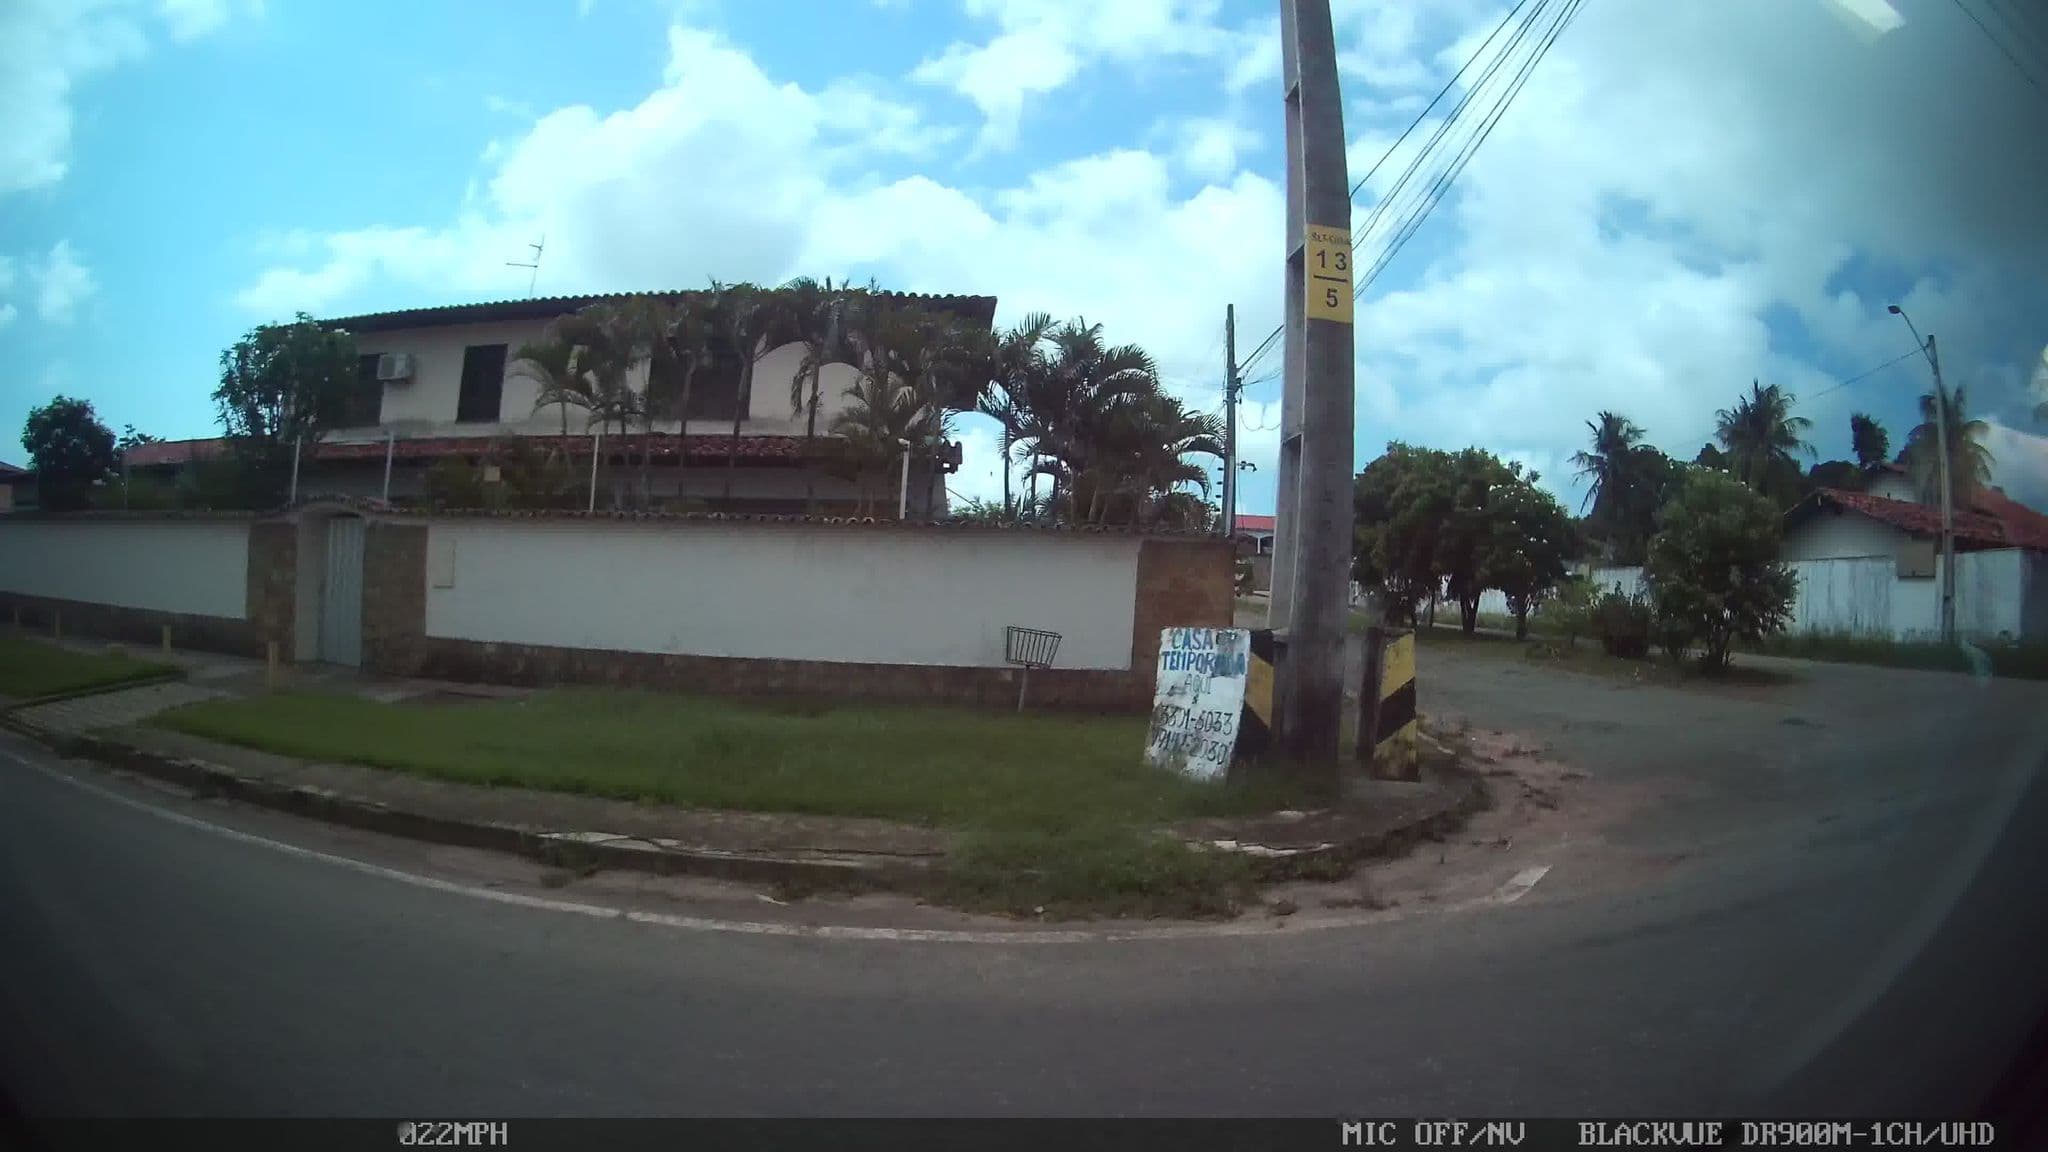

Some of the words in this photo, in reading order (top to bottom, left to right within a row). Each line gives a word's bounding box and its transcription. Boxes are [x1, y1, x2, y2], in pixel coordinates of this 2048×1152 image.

[1316, 249, 1347, 271] 13
[1326, 288, 1338, 308] 5
[1171, 628, 1214, 651] CASA
[1184, 673, 1212, 695] AQUI
